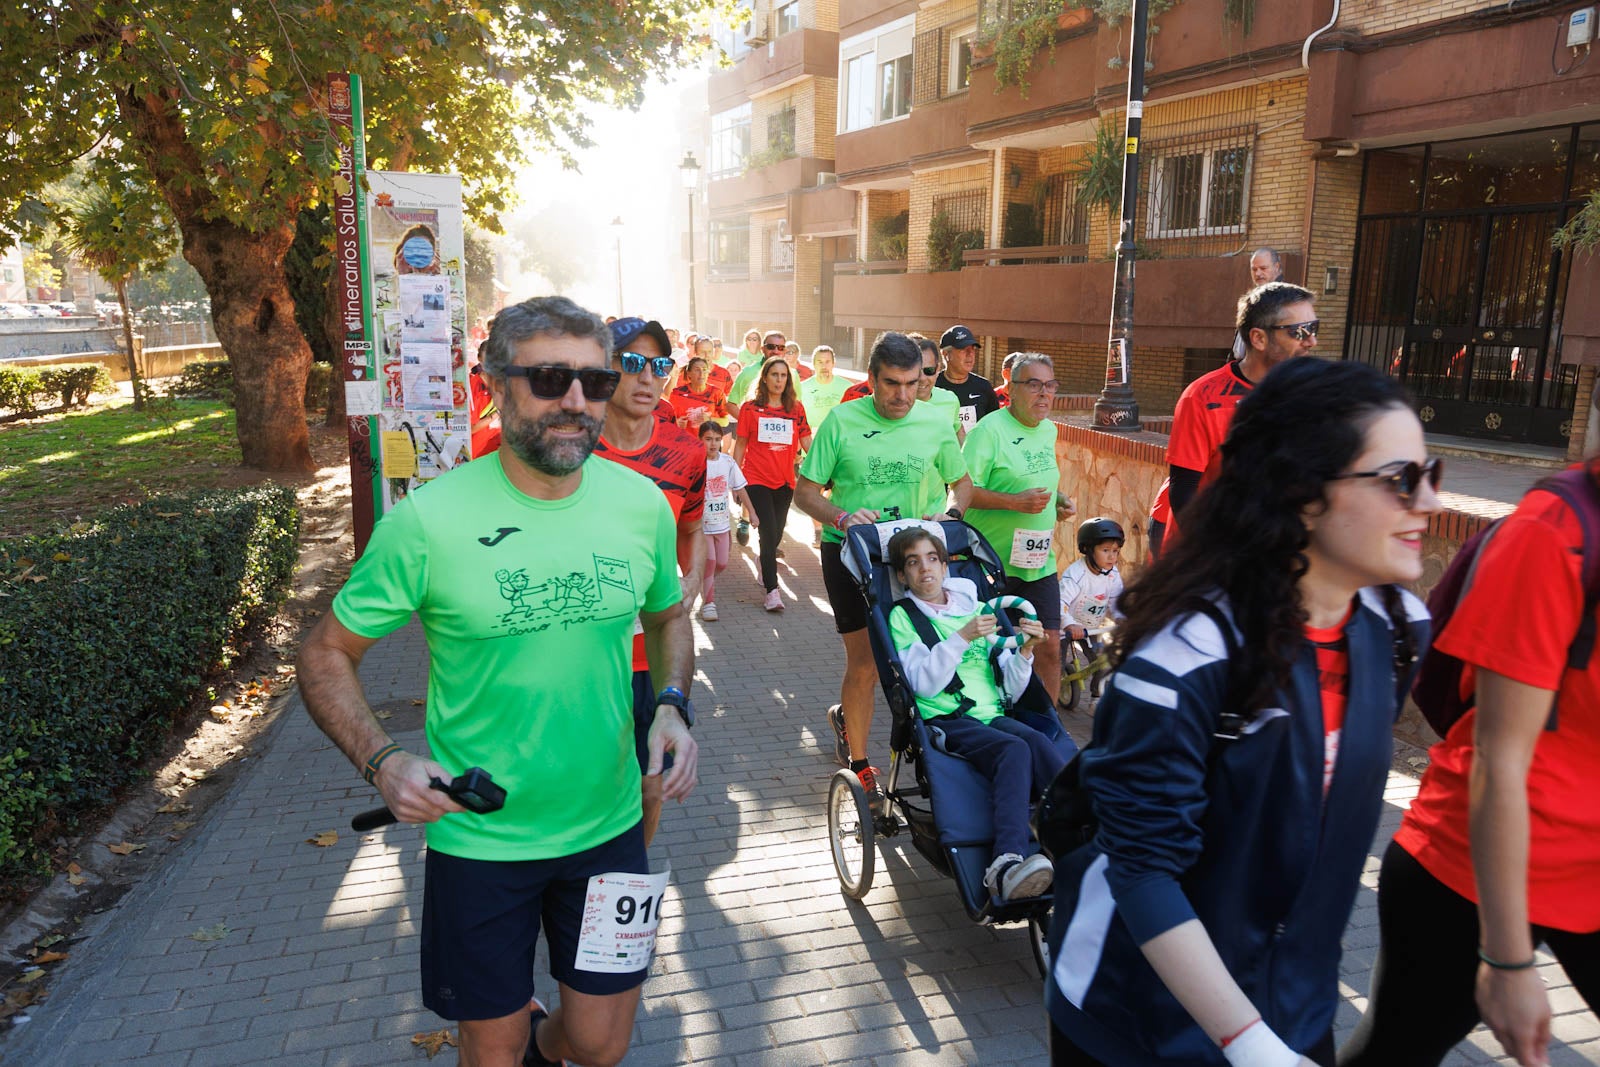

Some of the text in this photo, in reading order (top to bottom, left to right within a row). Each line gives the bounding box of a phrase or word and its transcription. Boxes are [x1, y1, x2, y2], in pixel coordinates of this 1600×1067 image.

[1485, 185, 1496, 203] 2
[345, 341, 371, 349] MPS
[764, 423, 787, 432] 1361
[1026, 538, 1050, 551] 943
[1088, 605, 1105, 616] 47
